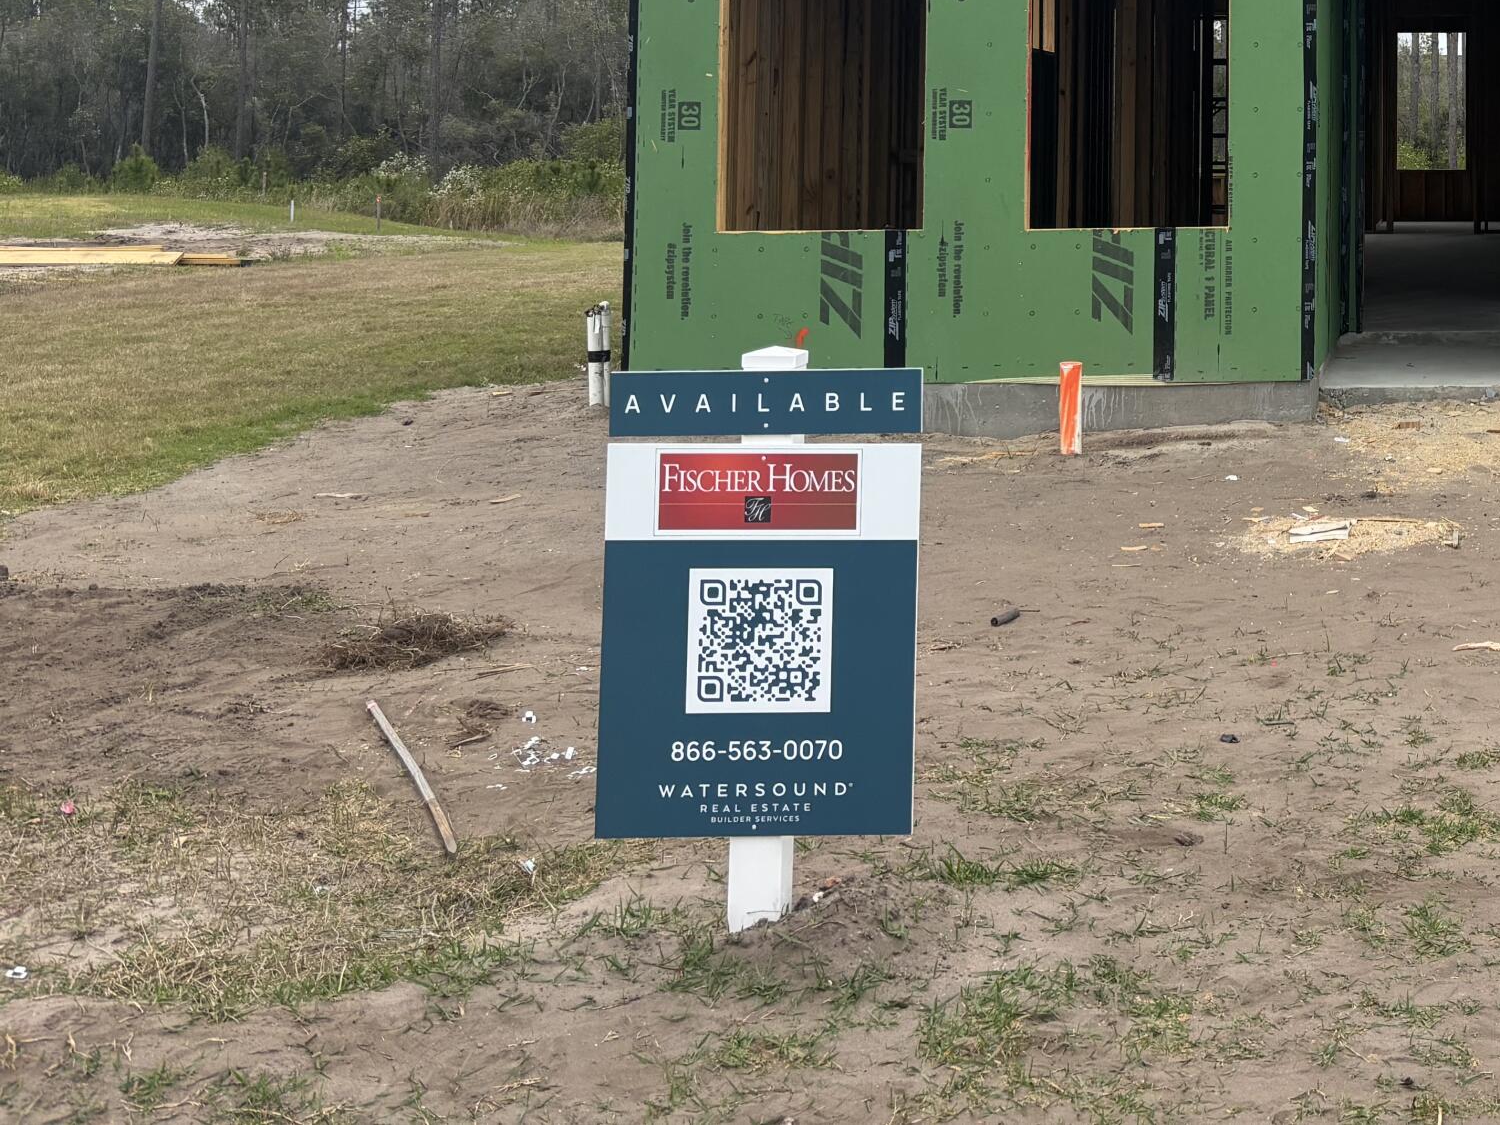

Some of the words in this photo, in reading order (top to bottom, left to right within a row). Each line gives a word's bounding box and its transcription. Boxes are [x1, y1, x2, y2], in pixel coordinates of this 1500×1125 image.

[624, 391, 906, 414] AVAILABLE
[671, 740, 843, 762] 866-563-0070
[700, 804, 744, 813] REAL
[751, 803, 812, 813] ESTATE
[710, 815, 752, 824] BUILDER
[754, 815, 800, 824] SERVICES
